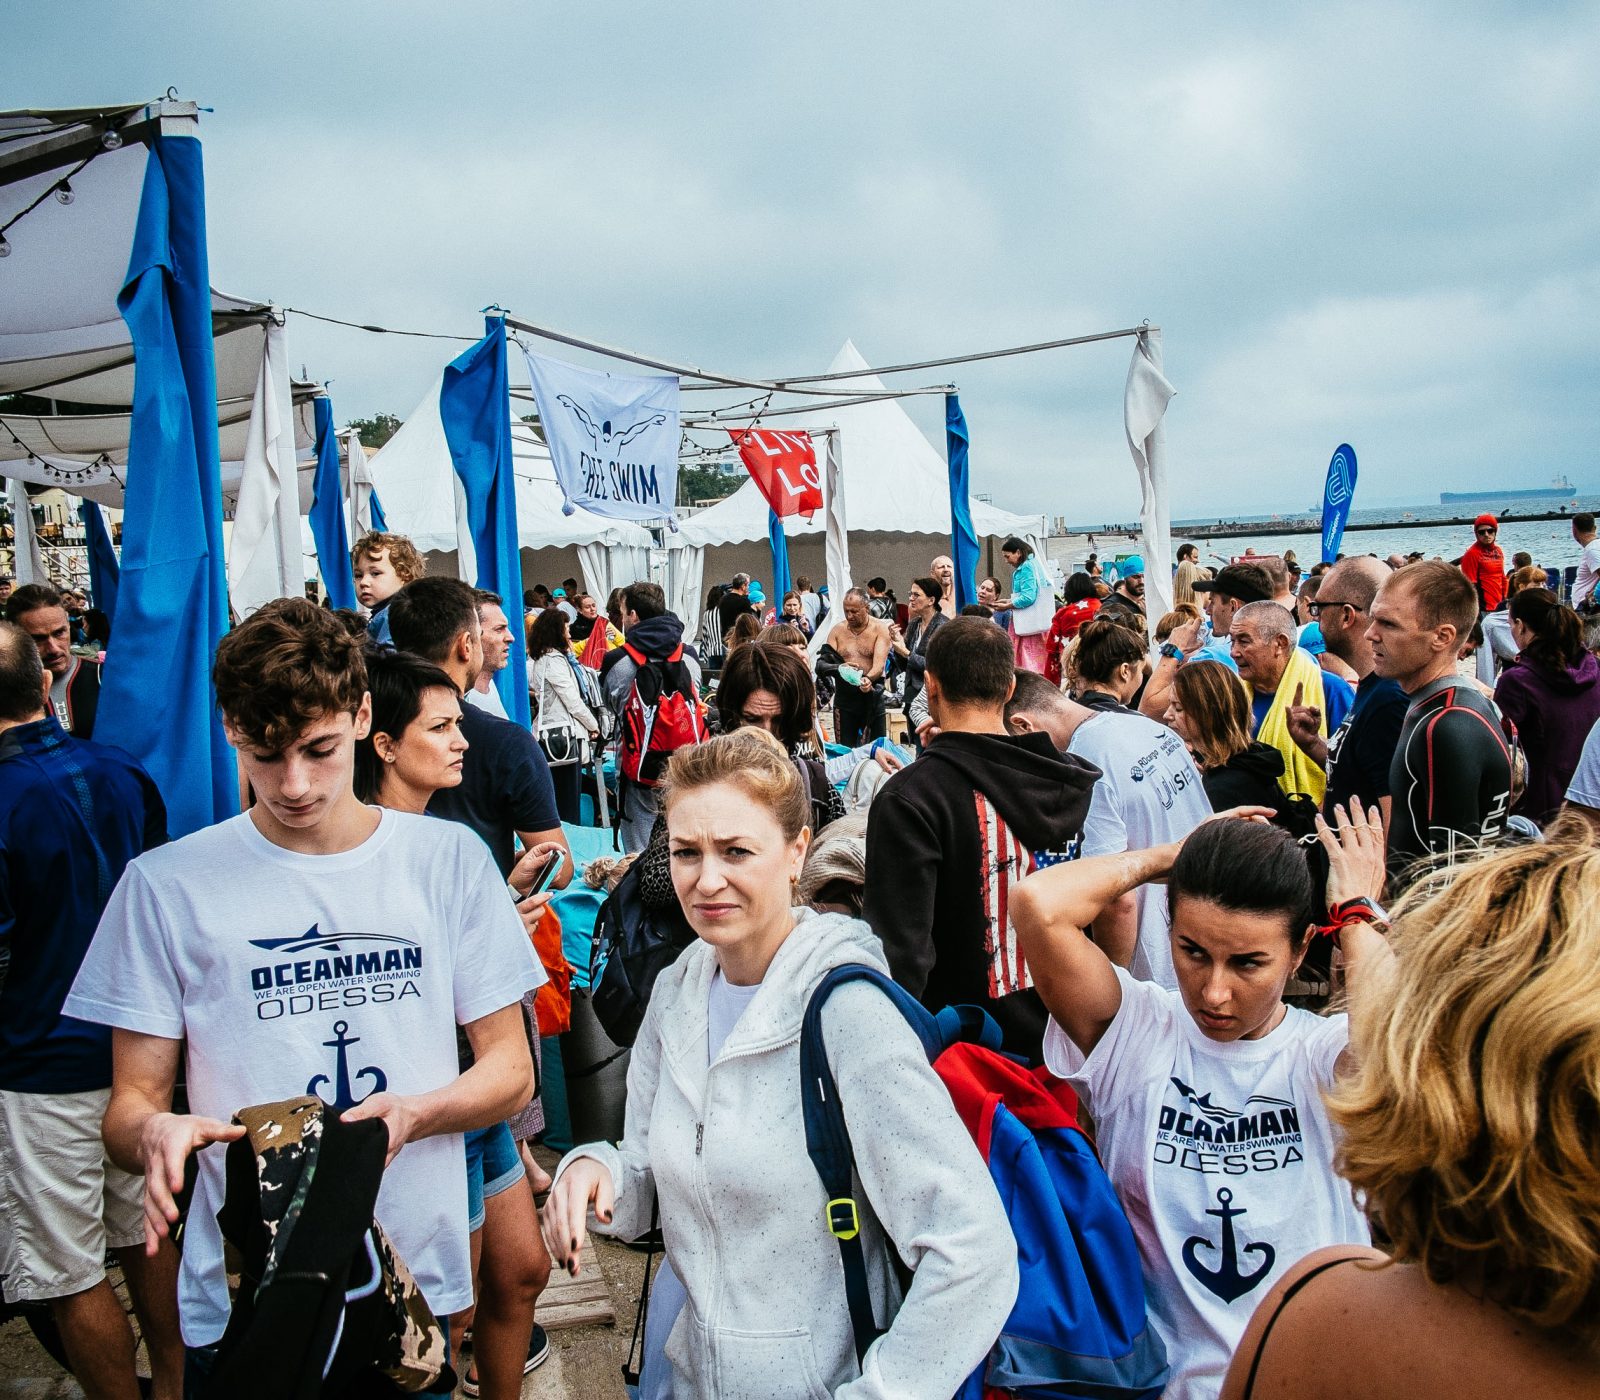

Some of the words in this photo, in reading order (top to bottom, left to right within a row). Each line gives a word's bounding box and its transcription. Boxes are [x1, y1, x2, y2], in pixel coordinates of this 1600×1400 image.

[609, 461, 661, 505] SWIM
[250, 946, 423, 991] OCEANMAN
[254, 990, 273, 1000] WE
[275, 985, 296, 997] ARE
[297, 981, 326, 994] OPEN
[328, 976, 364, 989] WATER
[366, 969, 422, 984] SWIMMING
[256, 980, 422, 1021] ODESSA
[1171, 1134, 1193, 1147] ARE
[1207, 1142, 1246, 1154] WATER
[1246, 1133, 1303, 1151] SWIMMING
